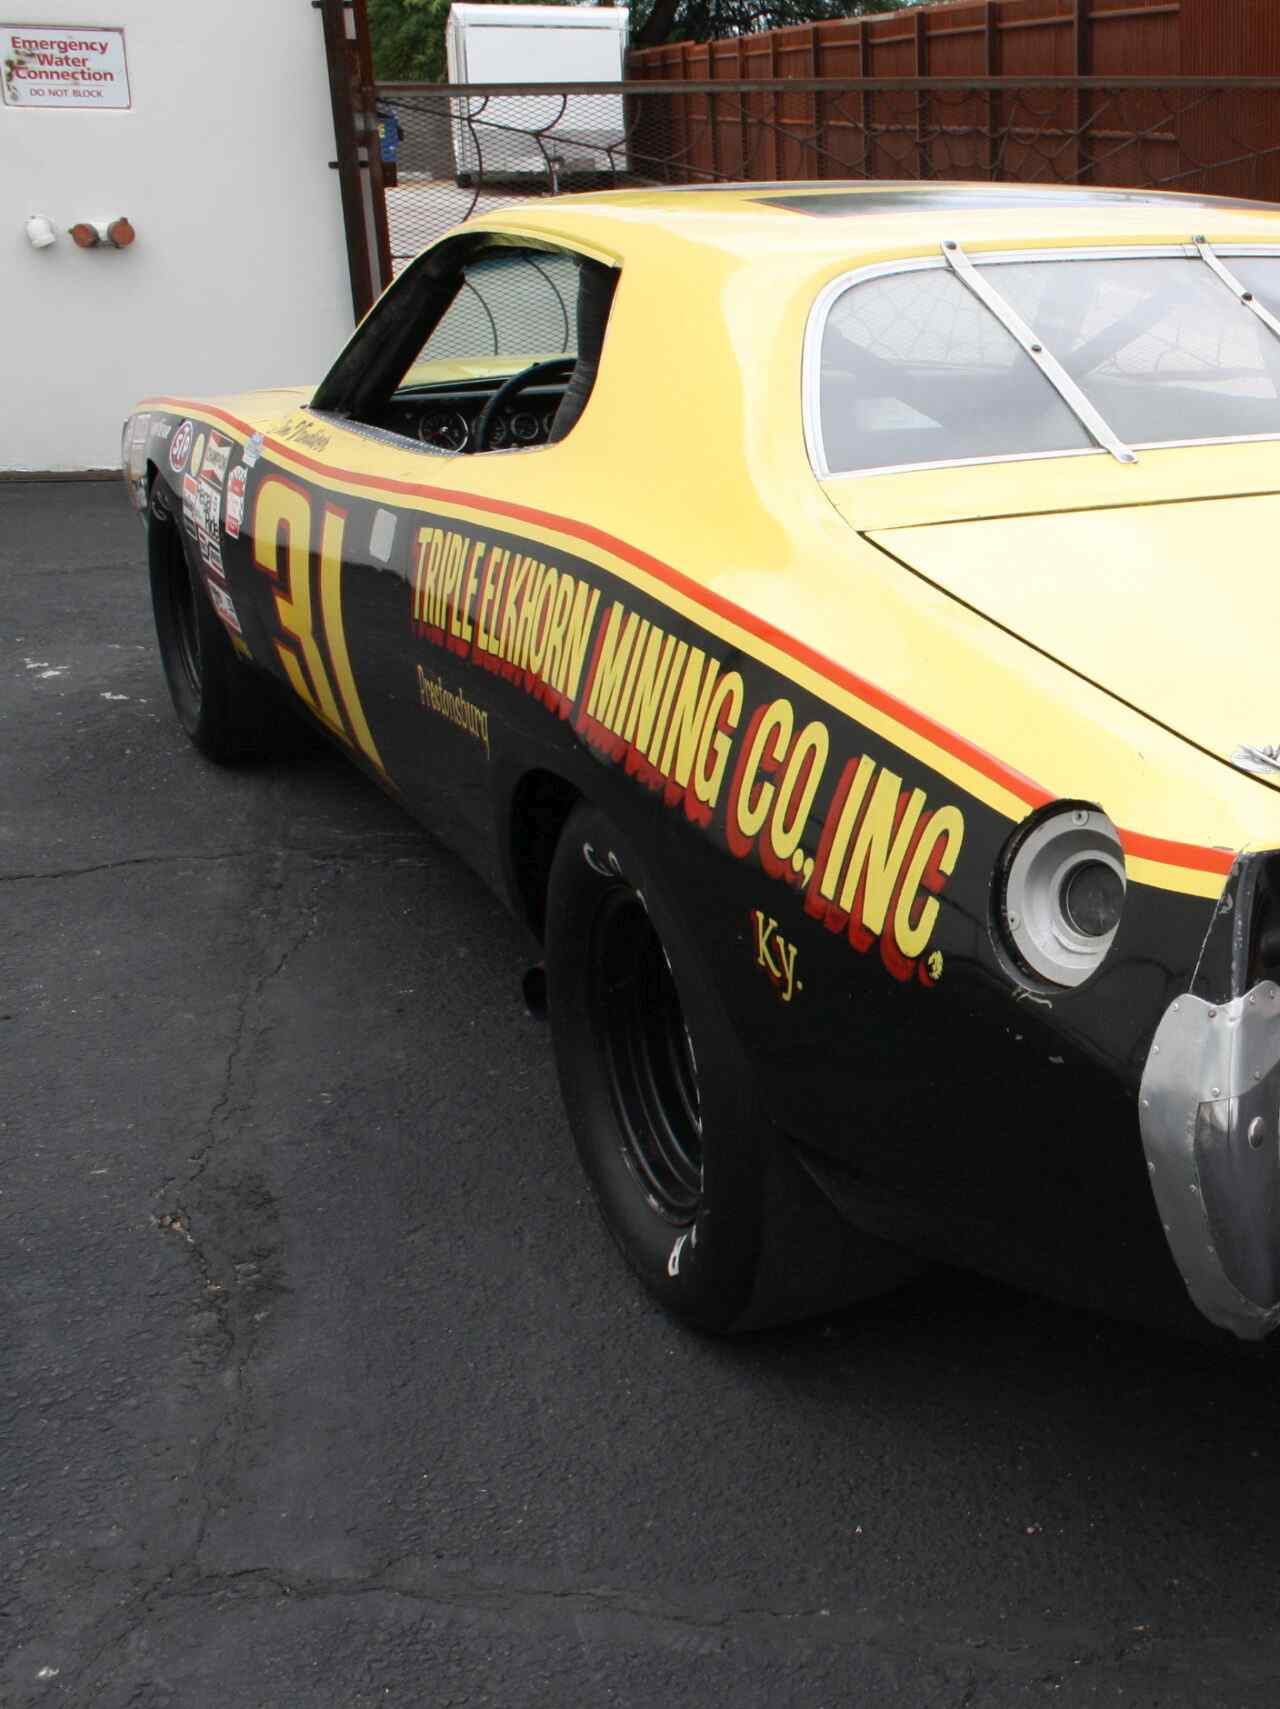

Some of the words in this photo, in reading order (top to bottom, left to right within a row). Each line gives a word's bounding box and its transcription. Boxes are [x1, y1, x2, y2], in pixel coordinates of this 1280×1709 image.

[11, 36, 109, 54] Emergency
[35, 53, 89, 68] Water
[13, 67, 115, 82] Connection
[30, 88, 46, 97] DO
[48, 88, 68, 98] NOT
[72, 89, 104, 99] BLOCK
[413, 526, 486, 644] TRIPLE
[475, 546, 601, 705] ELKHORN
[585, 600, 745, 812] MINING
[752, 909, 804, 1002] Ky.
